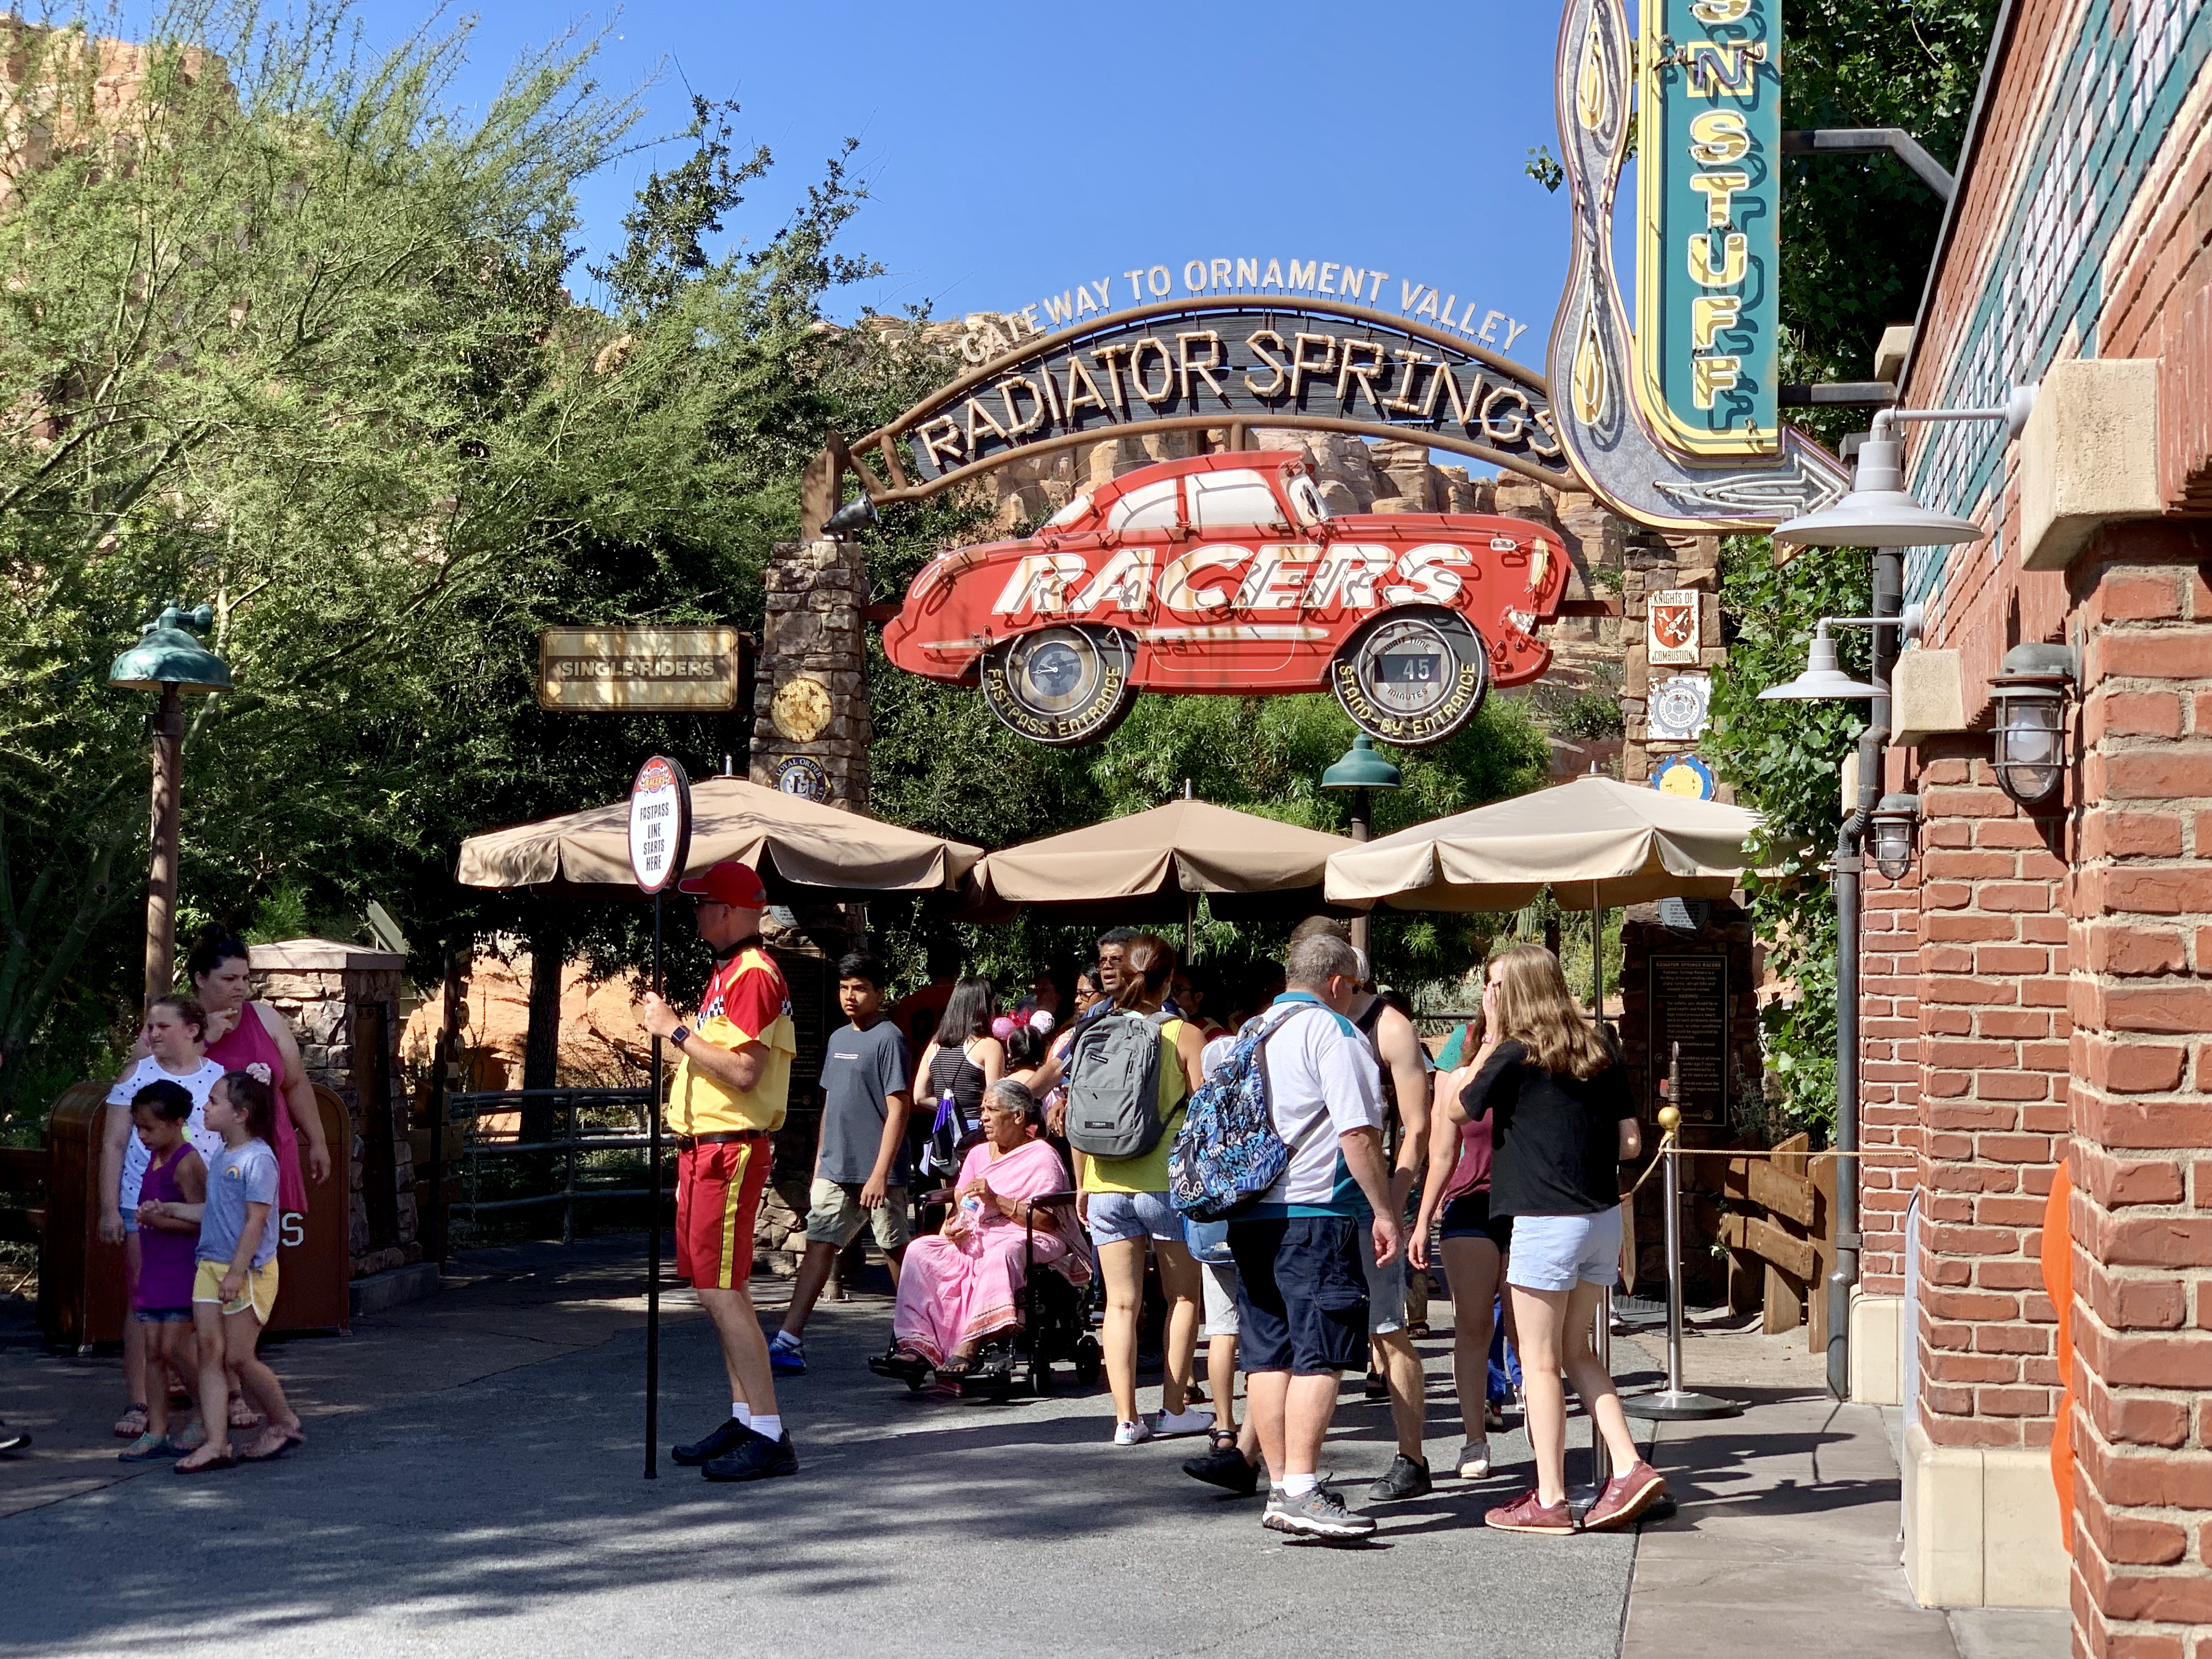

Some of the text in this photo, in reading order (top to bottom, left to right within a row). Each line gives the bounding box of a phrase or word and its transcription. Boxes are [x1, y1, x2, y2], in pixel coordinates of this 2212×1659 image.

[1687, 109, 1751, 411] STUFF
[961, 257, 1528, 362] GATEWAY TO ORNAMENT VALLEY
[916, 330, 1561, 466] RADIATOR SPRINGS
[992, 544, 1473, 615] RACERS
[1654, 592, 1694, 604] KNIGHTS OF
[1384, 636, 1431, 651] WAIT TIME
[1654, 650, 1692, 662] COMBUSTION
[562, 661, 714, 676] SINGLE RIDERS
[1403, 658, 1430, 680] 45
[988, 666, 1121, 736] FASTPASS ENTRANCE
[1339, 662, 1476, 736] STAND-BY ENTRANCE
[1387, 688, 1428, 701] MINUTES
[776, 759, 822, 778] LOYAL ORDER
[645, 776, 666, 788] RACERS
[640, 802, 669, 821] FASTPASS
[648, 822, 661, 839] LINE
[644, 839, 664, 855] STARTS
[646, 855, 661, 872] HERE
